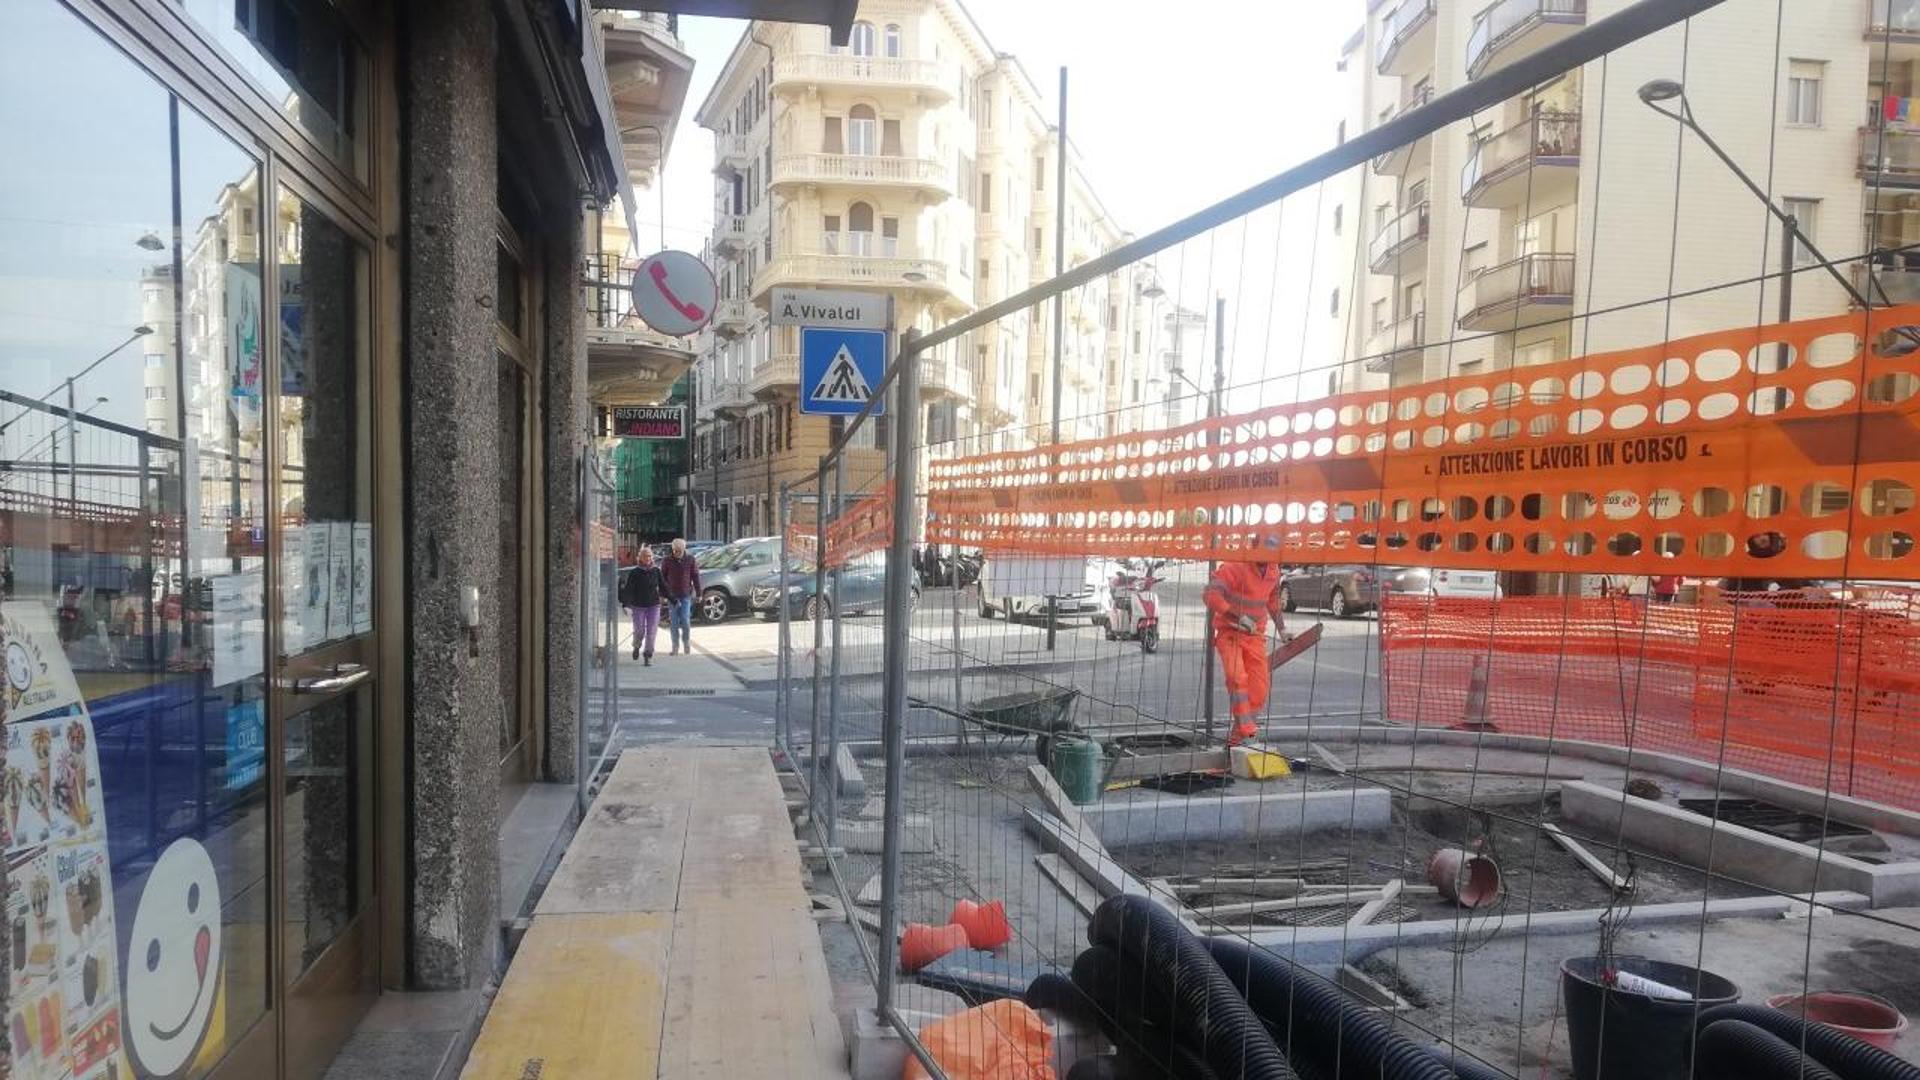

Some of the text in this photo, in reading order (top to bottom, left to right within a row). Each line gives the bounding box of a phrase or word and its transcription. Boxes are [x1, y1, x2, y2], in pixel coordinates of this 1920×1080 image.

[615, 408, 681, 420] RISTORANTE
[628, 423, 680, 437] INDIANO
[1439, 435, 1688, 476] ATTENZIONE LAVORI IN CORSO
[1252, 471, 1279, 488] CORSO
